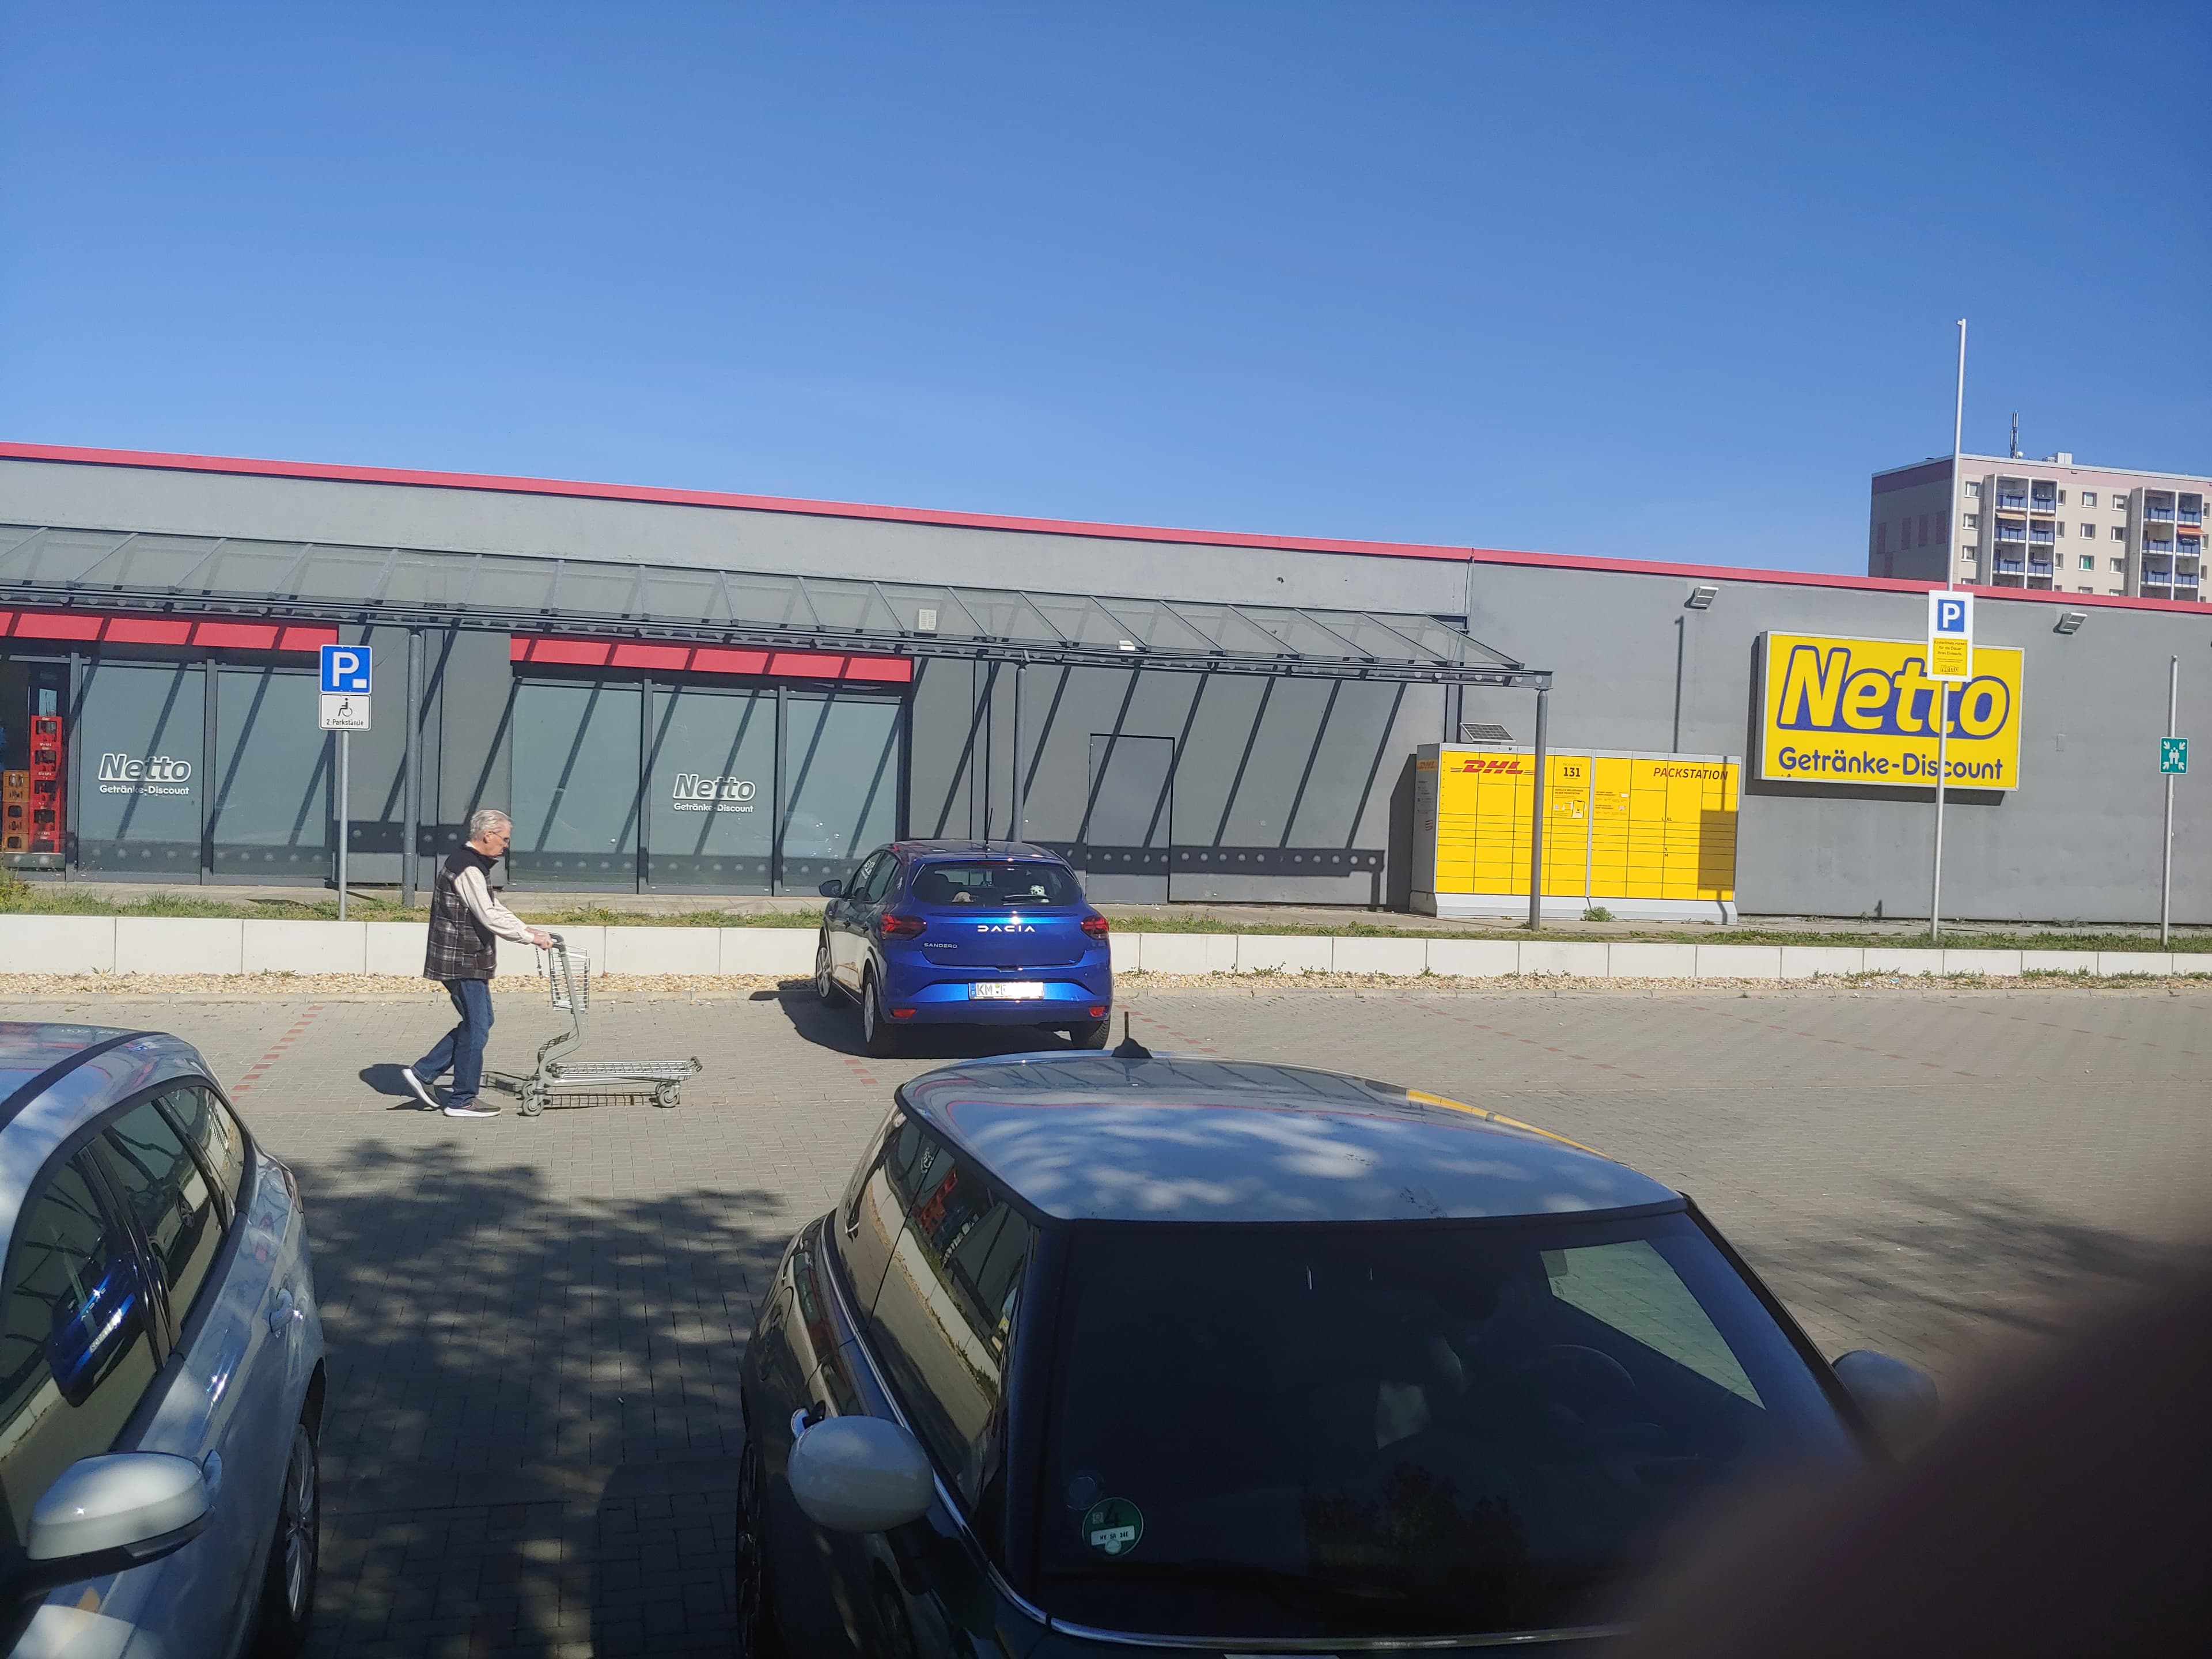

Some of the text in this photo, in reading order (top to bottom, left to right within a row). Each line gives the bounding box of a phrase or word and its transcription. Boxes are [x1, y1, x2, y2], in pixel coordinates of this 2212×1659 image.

[1943, 603, 1960, 628] P
[333, 652, 359, 687] P
[1940, 665, 1959, 673] Netto
[1777, 645, 2010, 740] Netto
[99, 753, 191, 782] Netto
[1462, 760, 1524, 774] DHL
[1563, 767, 1580, 777] 131
[1779, 747, 2003, 780] Getränke-Discount
[1653, 768, 1728, 780] PACKSTATION
[99, 785, 190, 795] Getränke-Discount
[673, 774, 756, 801] Netto
[673, 802, 753, 813] Getränke-Discount
